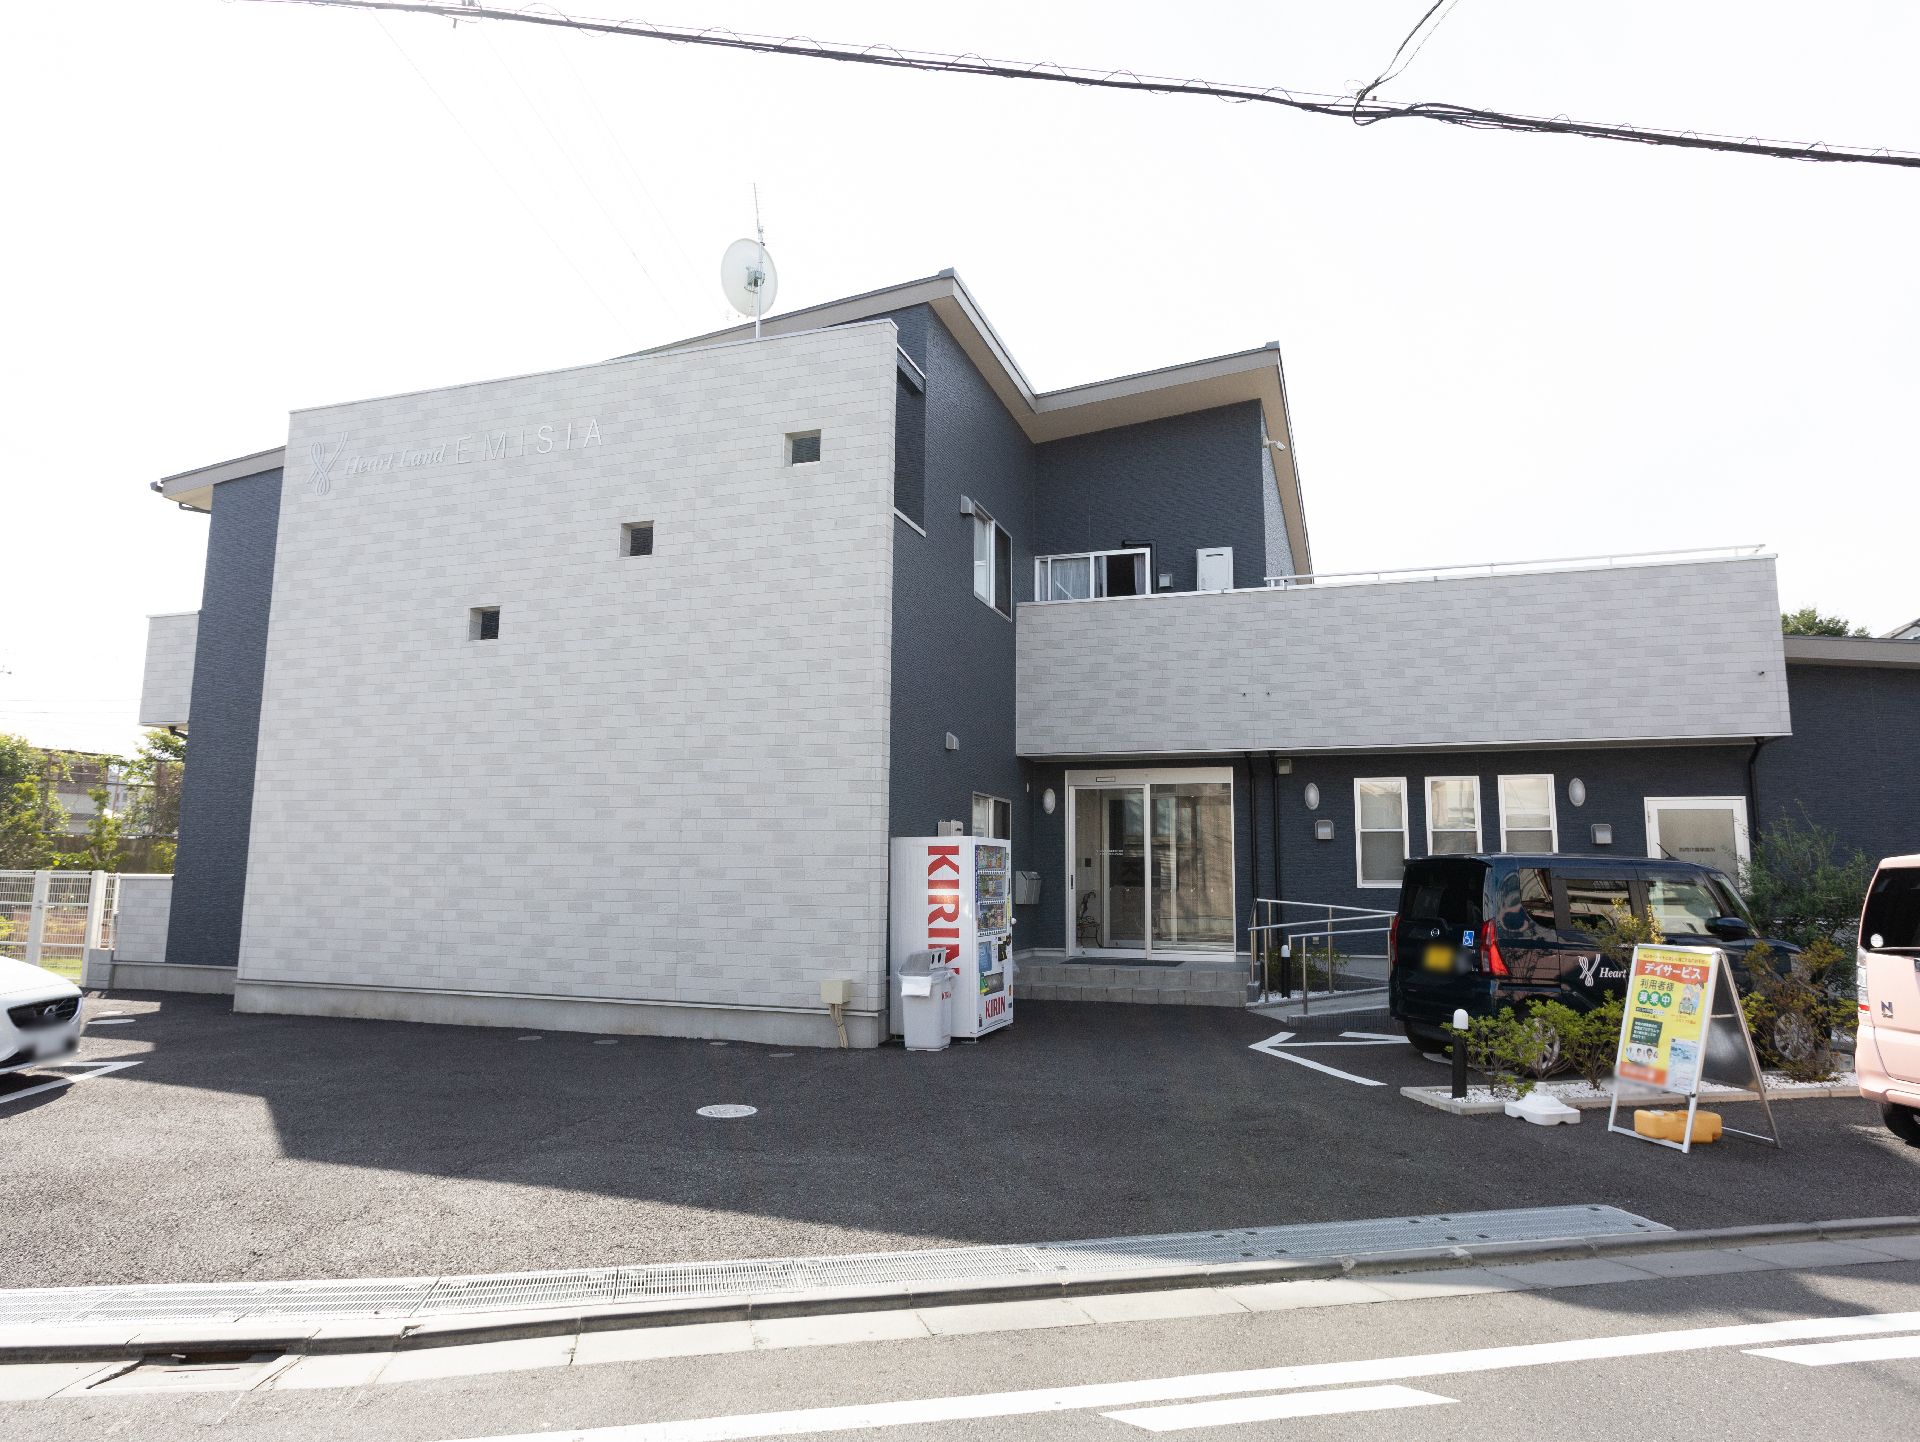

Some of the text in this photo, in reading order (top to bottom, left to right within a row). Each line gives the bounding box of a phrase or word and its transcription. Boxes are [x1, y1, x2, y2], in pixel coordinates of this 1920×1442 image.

[345, 452, 394, 474] Heart
[455, 419, 602, 464] EMISIA
[1599, 967, 1627, 978] Heart
[1645, 962, 1701, 979] デイサービス
[1640, 978, 1675, 991] 利用者様
[1638, 991, 1671, 1007] 募集中
[985, 996, 1005, 1019] KIRIN
